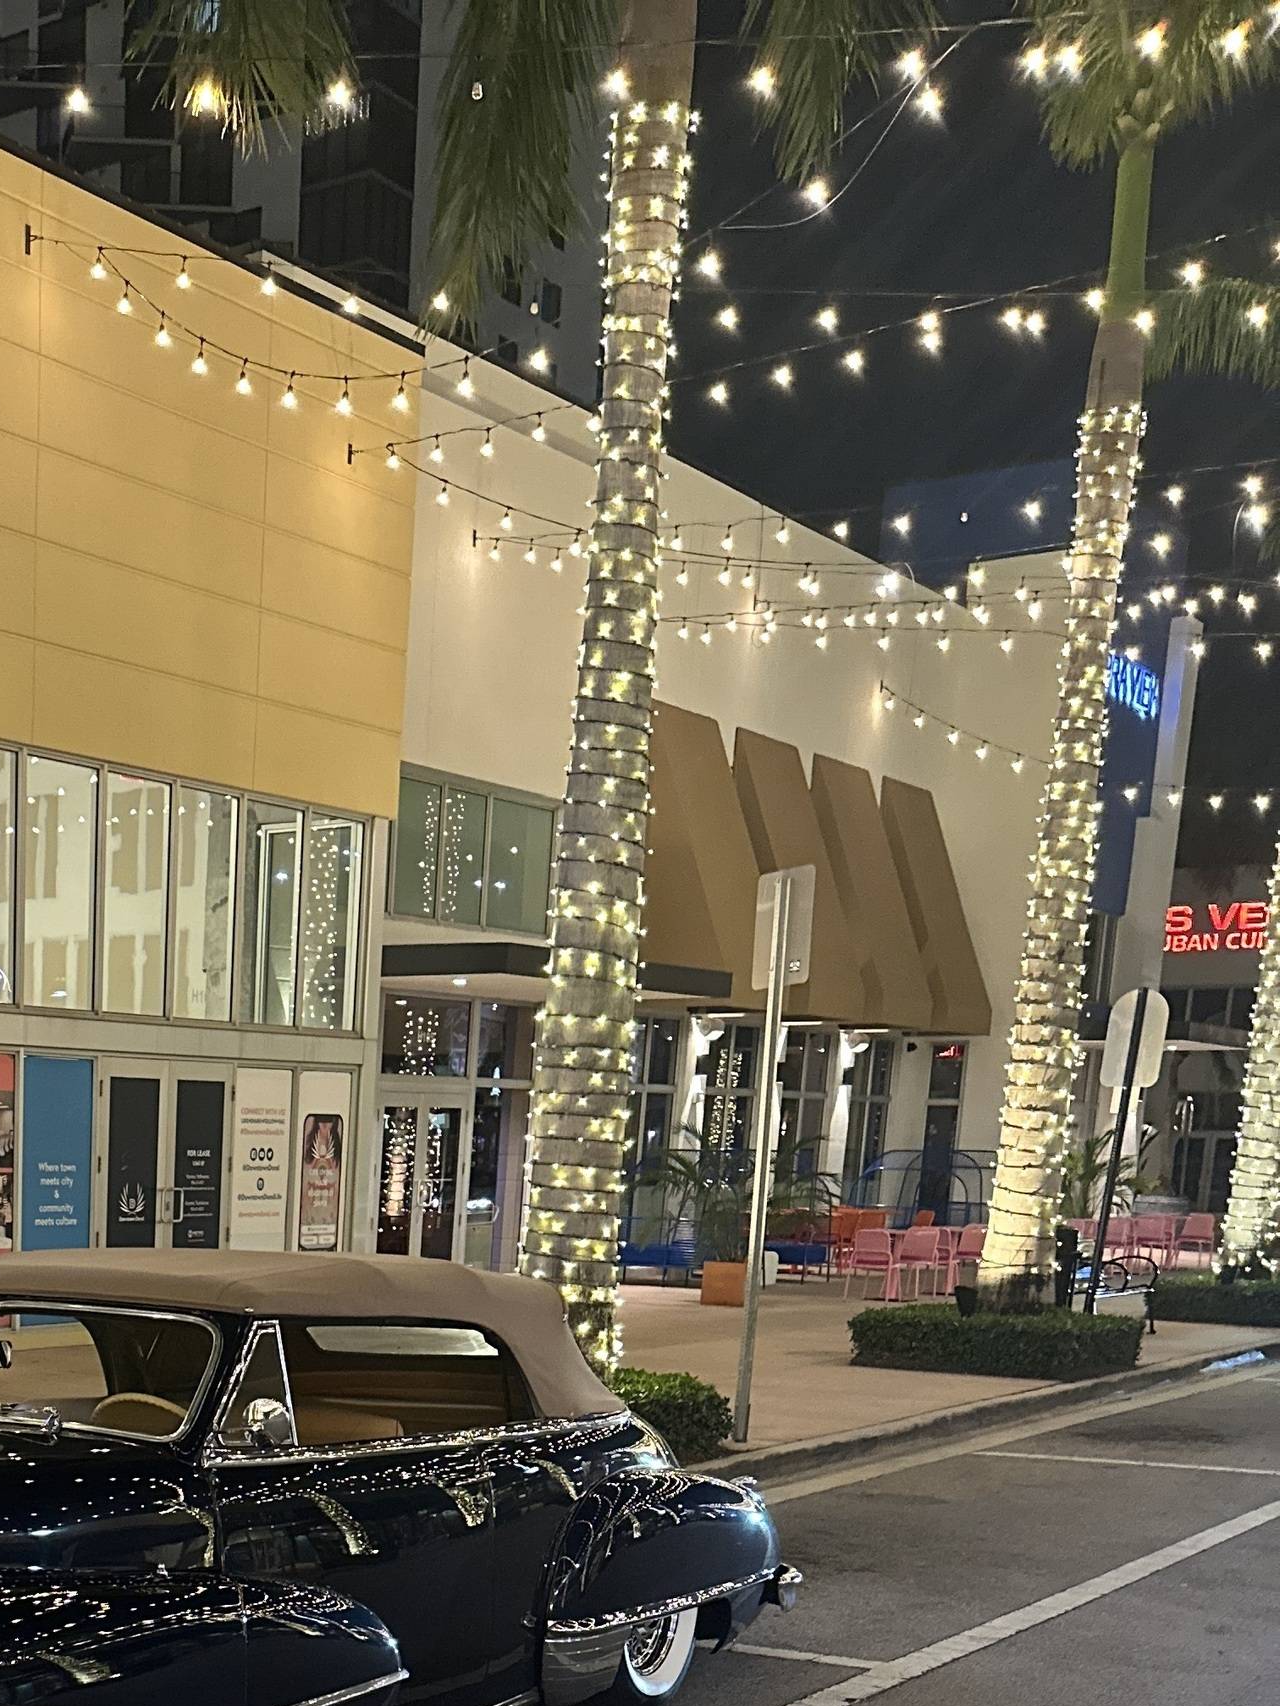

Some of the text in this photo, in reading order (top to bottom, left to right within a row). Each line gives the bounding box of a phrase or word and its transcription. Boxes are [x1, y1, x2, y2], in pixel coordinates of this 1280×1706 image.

[38, 1162, 77, 1173] Where town
[40, 1176, 74, 1189] meets city
[39, 1203, 74, 1215] community
[34, 1216, 78, 1227] meets culture
